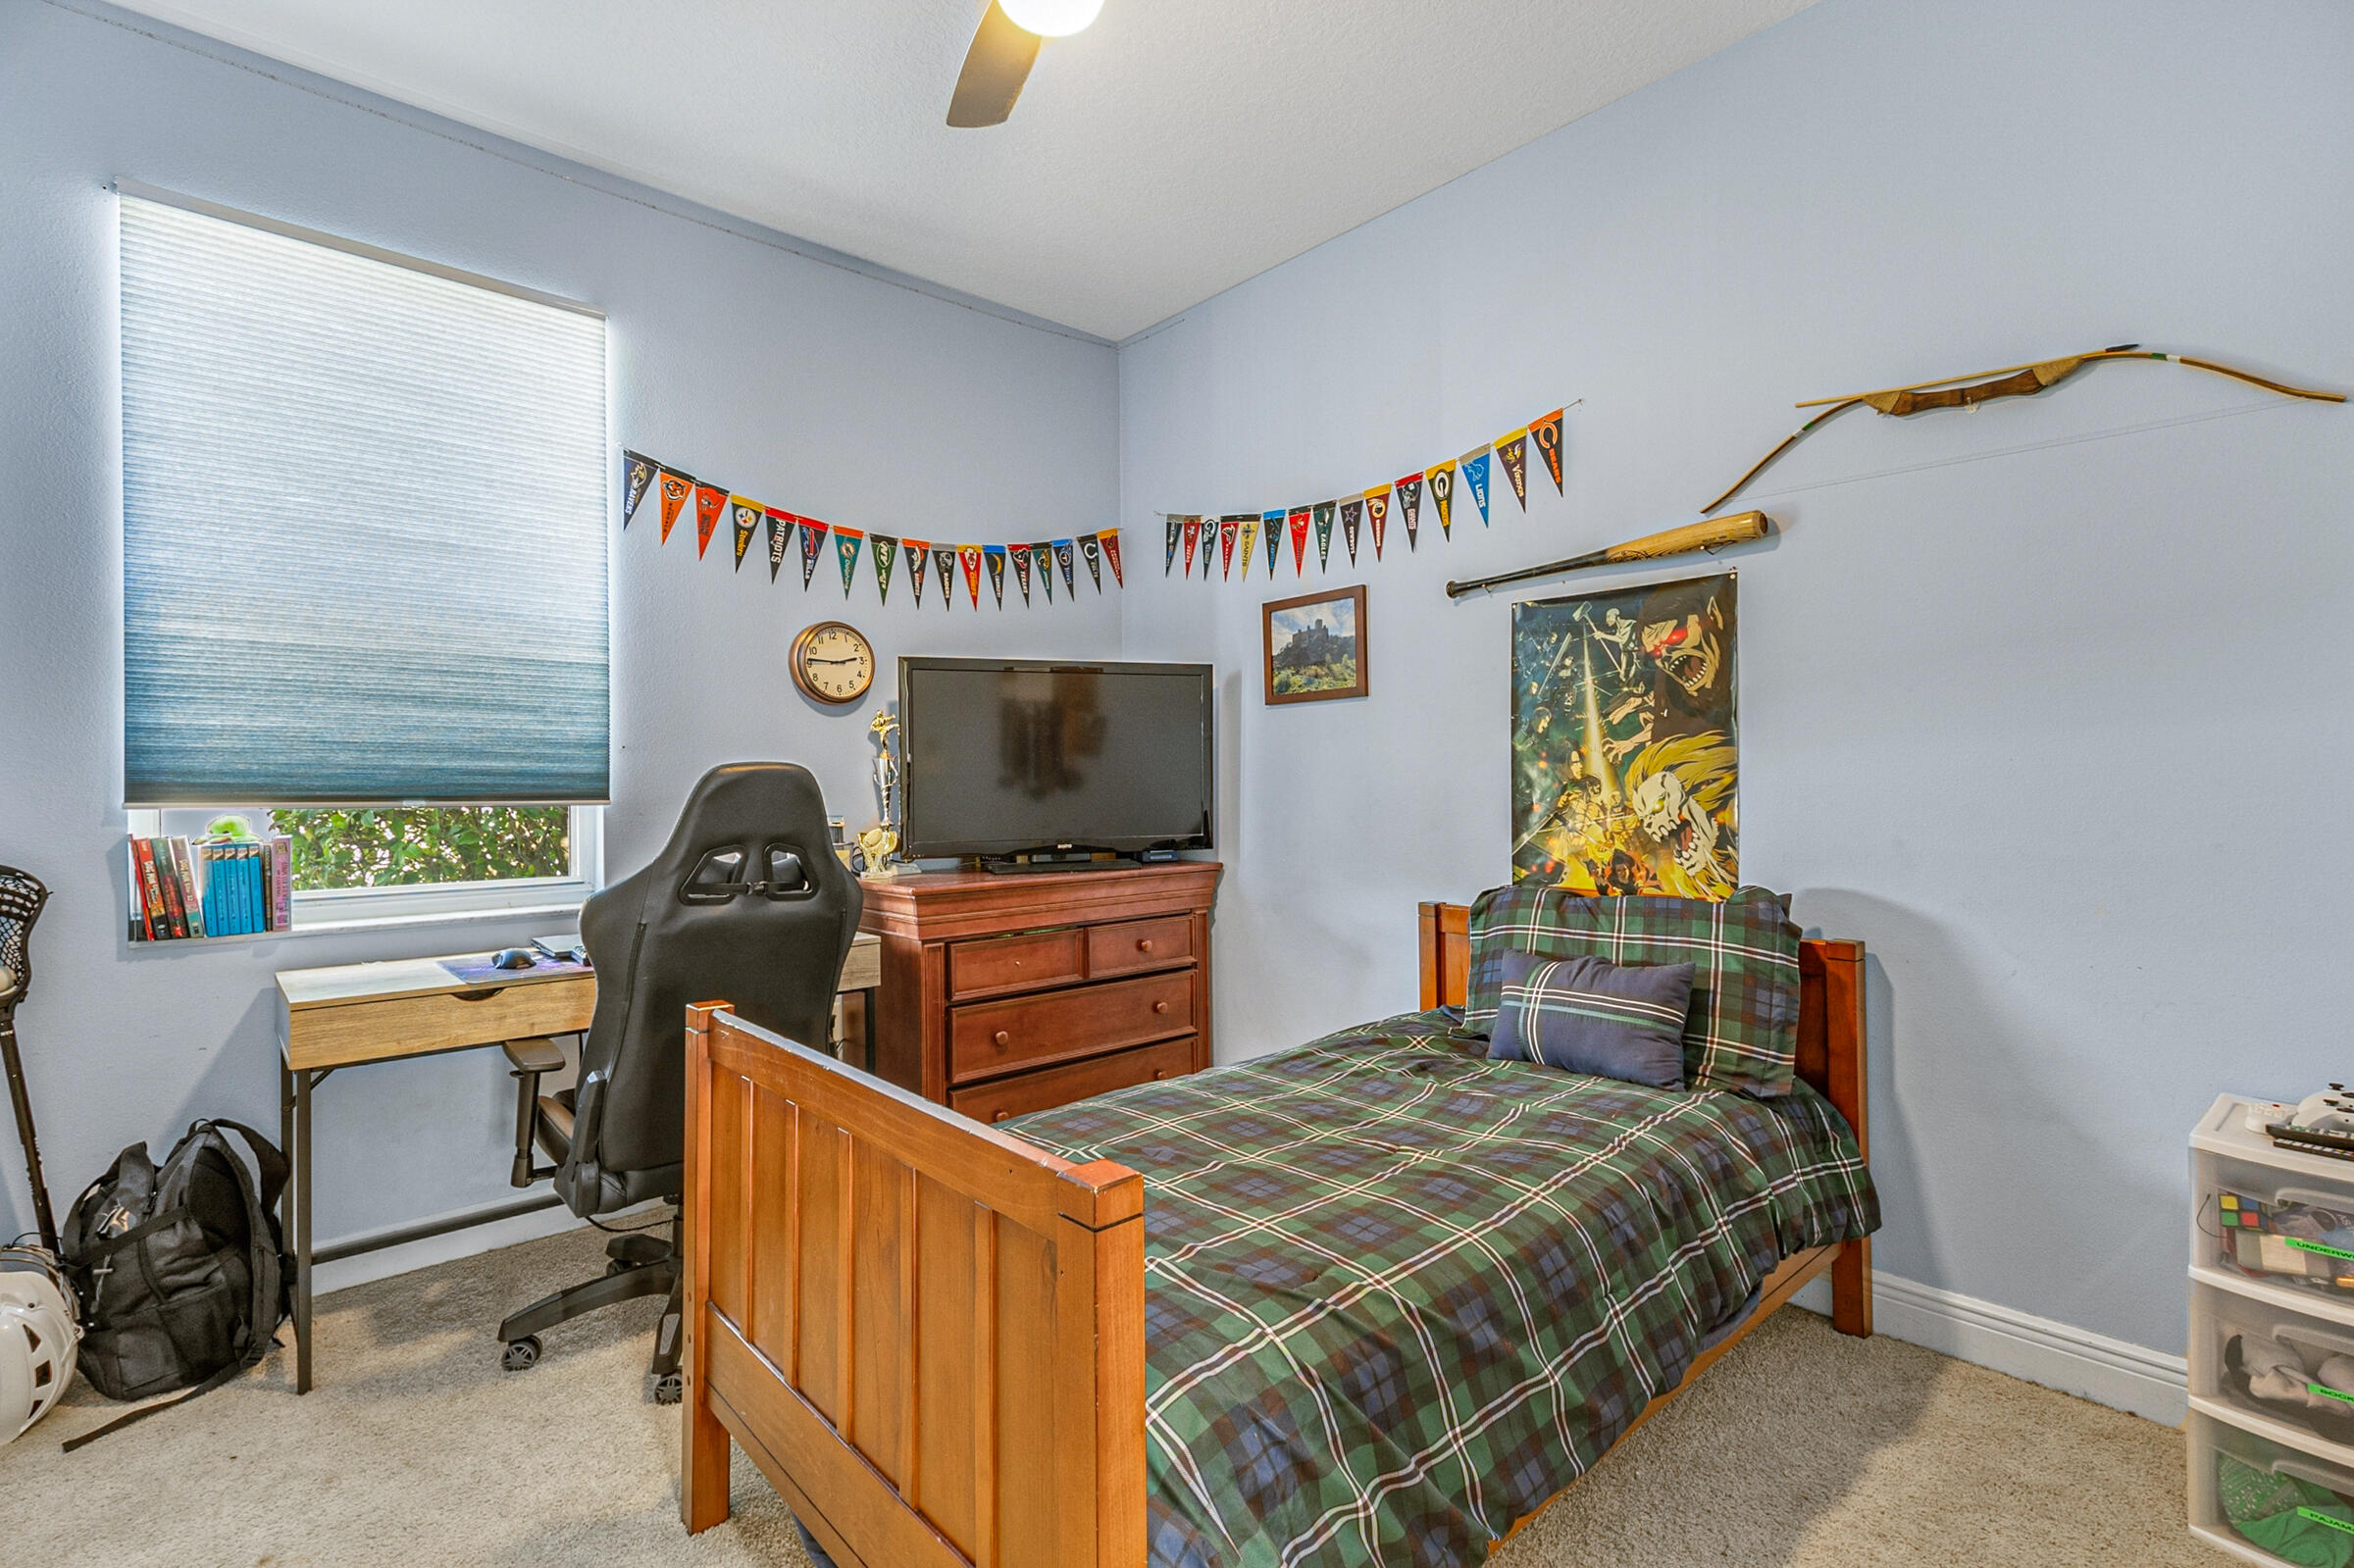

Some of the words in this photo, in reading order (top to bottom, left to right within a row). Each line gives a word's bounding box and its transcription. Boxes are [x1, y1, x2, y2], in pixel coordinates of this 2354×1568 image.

[1547, 447, 1561, 483] BEARS
[625, 488, 638, 516] RAVENS
[663, 502, 674, 532] BENGALS
[736, 529, 748, 557] Steelers
[770, 518, 787, 564] PATRIOTS
[1241, 540, 1250, 567] SAINTS
[804, 558, 813, 580] BILLS
[817, 635, 824, 644] 11
[829, 631, 837, 640] 12
[808, 646, 818, 655] 10
[853, 643, 859, 652] 2
[858, 656, 864, 665] 3
[812, 673, 818, 682] 8
[848, 680, 854, 688] 5
[823, 682, 829, 690] 7
[837, 683, 843, 693] 6
[2296, 1241, 2354, 1259] UNDERW
[2310, 1512, 2354, 1533] PAJAM
